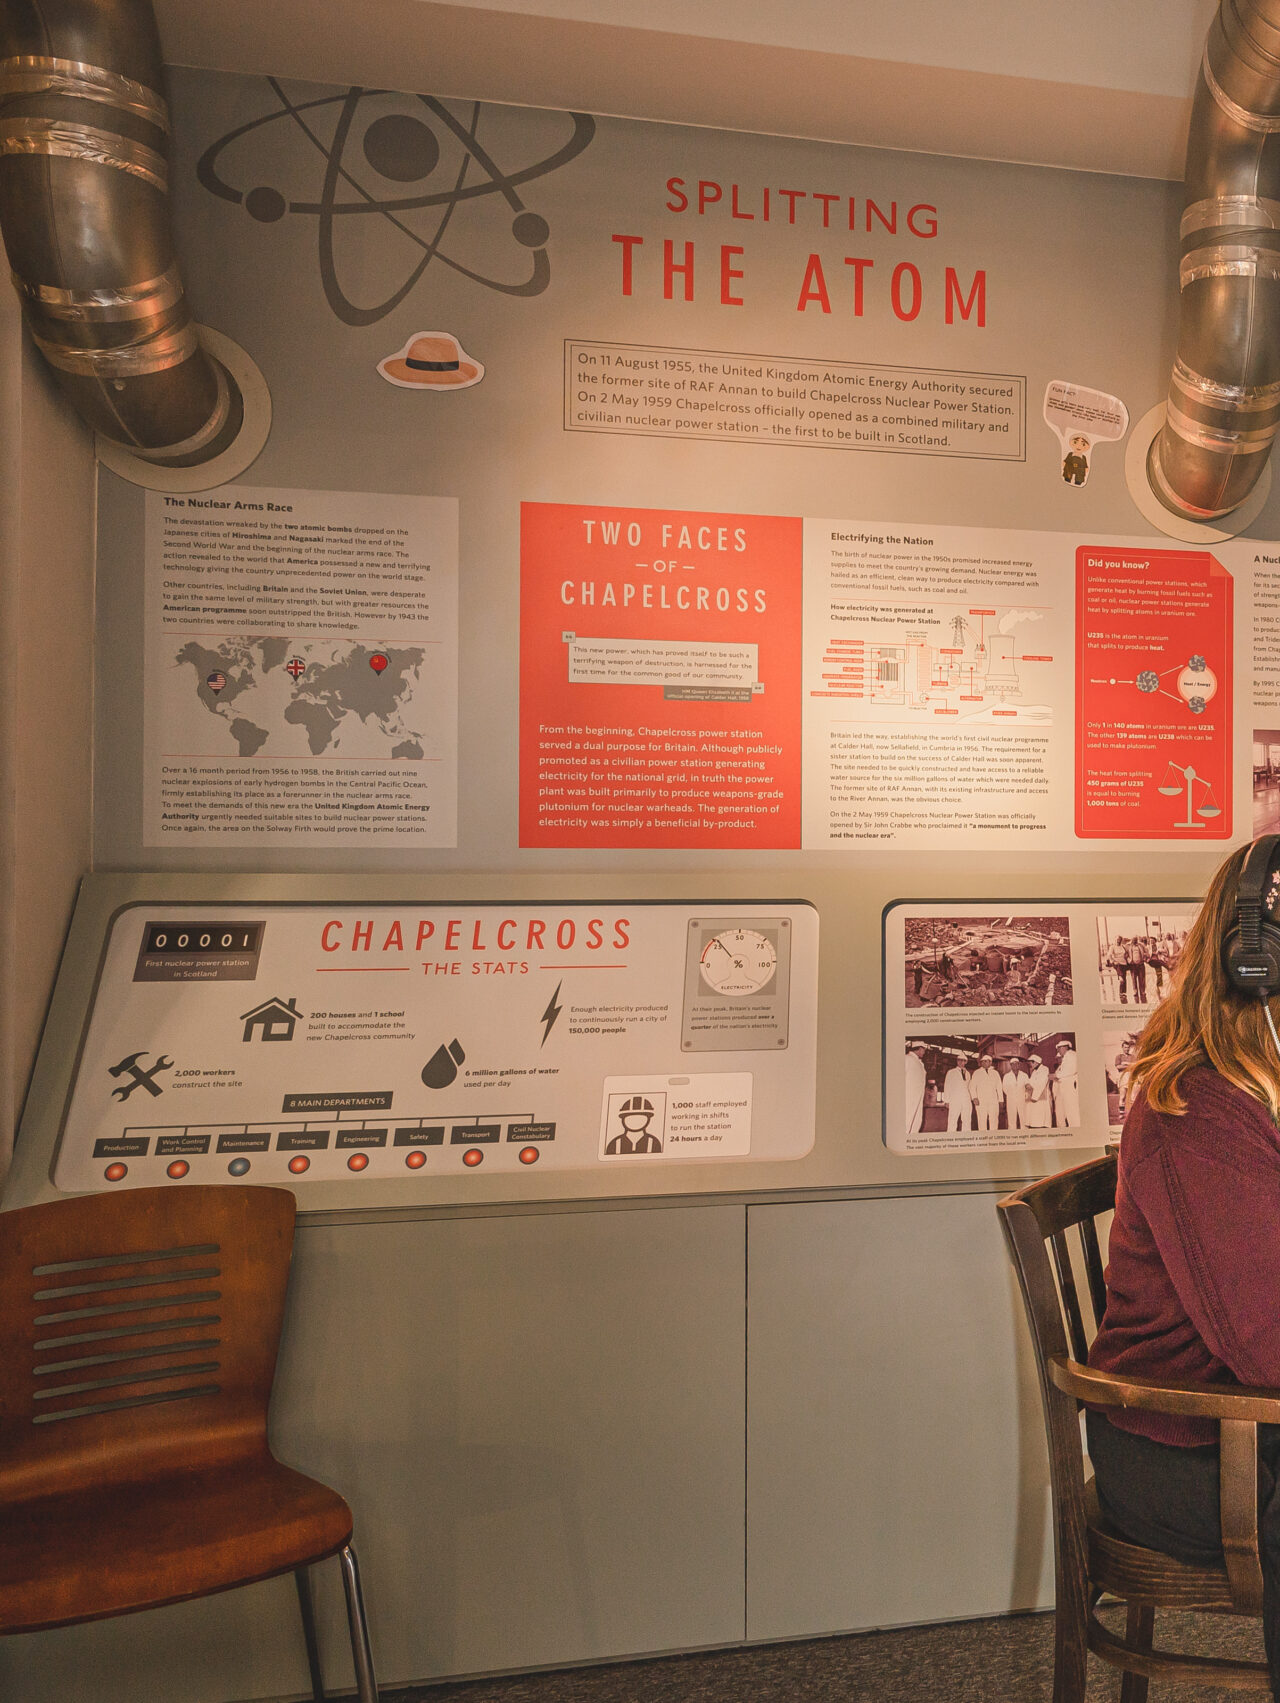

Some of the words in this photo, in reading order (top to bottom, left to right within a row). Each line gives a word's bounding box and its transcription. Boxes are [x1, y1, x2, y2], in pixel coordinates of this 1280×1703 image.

[665, 176, 938, 239] SPLITTING
[611, 233, 744, 306] THE
[796, 253, 986, 328] ATOM
[577, 351, 597, 365] On
[599, 354, 610, 366] 11
[614, 355, 659, 370] August
[662, 359, 695, 374] 1955,
[698, 362, 718, 374] the
[721, 363, 762, 378] United
[765, 367, 819, 383] Kingdom
[822, 371, 865, 386] Atomic
[868, 375, 908, 391] Energy
[910, 378, 966, 396] Authority
[968, 385, 1013, 397] secured
[576, 371, 598, 384] the
[601, 372, 644, 387] former
[647, 377, 670, 389] site
[673, 378, 686, 390] of
[689, 379, 715, 392] RAF
[717, 382, 757, 396] Annan
[760, 386, 774, 397] to
[776, 386, 806, 399] build
[809, 389, 882, 405] Chapelcross
[884, 394, 930, 409] Nuclear
[933, 398, 968, 412] Power
[970, 401, 1014, 415] Station.
[576, 390, 596, 402] On
[599, 391, 608, 404] 2
[611, 392, 639, 408] May
[642, 395, 672, 408] 1959
[675, 397, 751, 414] Chapelcross
[753, 403, 805, 420] officially
[807, 409, 852, 421] opened
[854, 413, 868, 422] as
[871, 414, 878, 423] a
[881, 414, 938, 428] combined
[941, 417, 985, 433] military
[987, 421, 1009, 433] and
[576, 409, 621, 423] civilian
[625, 413, 671, 426] nuclear
[674, 418, 713, 430] power
[716, 420, 759, 433] station
[771, 423, 791, 435] the
[794, 424, 818, 437] first
[821, 427, 834, 438] to
[836, 427, 851, 439] be
[854, 428, 881, 442] built
[883, 431, 895, 442] in
[897, 431, 951, 446] Scotland.
[162, 496, 185, 507] The
[187, 497, 231, 509] Nuclear
[233, 500, 264, 511] Arms
[266, 501, 293, 512] Race
[582, 519, 641, 547] TWO
[661, 523, 746, 552] FACES
[830, 531, 884, 544] Electrifying
[885, 534, 901, 544] the
[902, 535, 933, 546] Nation
[1087, 558, 1103, 567] Did
[1104, 560, 1121, 569] you
[1121, 559, 1150, 569] know?
[1253, 554, 1261, 563] A
[652, 559, 677, 573] OF
[560, 579, 766, 613] CHAPELCROSS
[538, 723, 564, 734] From
[566, 724, 583, 734] the
[584, 724, 635, 737] beginning,
[637, 725, 696, 737] Chapelcross
[697, 729, 728, 738] power
[729, 729, 763, 738] station
[320, 918, 630, 952] CHAPELCROSS
[144, 959, 163, 967] First
[163, 959, 194, 967] nuclear
[420, 961, 462, 975] THE
[470, 960, 529, 975] STATS
[182, 969, 218, 977] Scotland
[569, 1005, 597, 1013] Enough
[597, 1004, 634, 1012] electricity
[634, 1003, 669, 1012] produced
[577, 1015, 624, 1024] continuously
[644, 1015, 658, 1023] city
[567, 1026, 601, 1034] 150,000
[600, 1026, 626, 1034] people
[173, 1069, 201, 1077] 2,000
[201, 1068, 235, 1076] workers
[171, 1080, 211, 1089] construct
[211, 1080, 226, 1088] the
[227, 1079, 243, 1087] site
[289, 1099, 296, 1107] 8
[296, 1099, 322, 1107] MAIN
[322, 1096, 385, 1106] DEPARTMENTS
[671, 1101, 694, 1109] 1,000
[694, 1100, 711, 1108] staff
[712, 1099, 747, 1108] employed
[670, 1112, 700, 1121] working
[708, 1111, 729, 1119] shifts
[706, 1122, 732, 1130] station
[290, 1137, 316, 1145] Training
[709, 1134, 722, 1142] day
